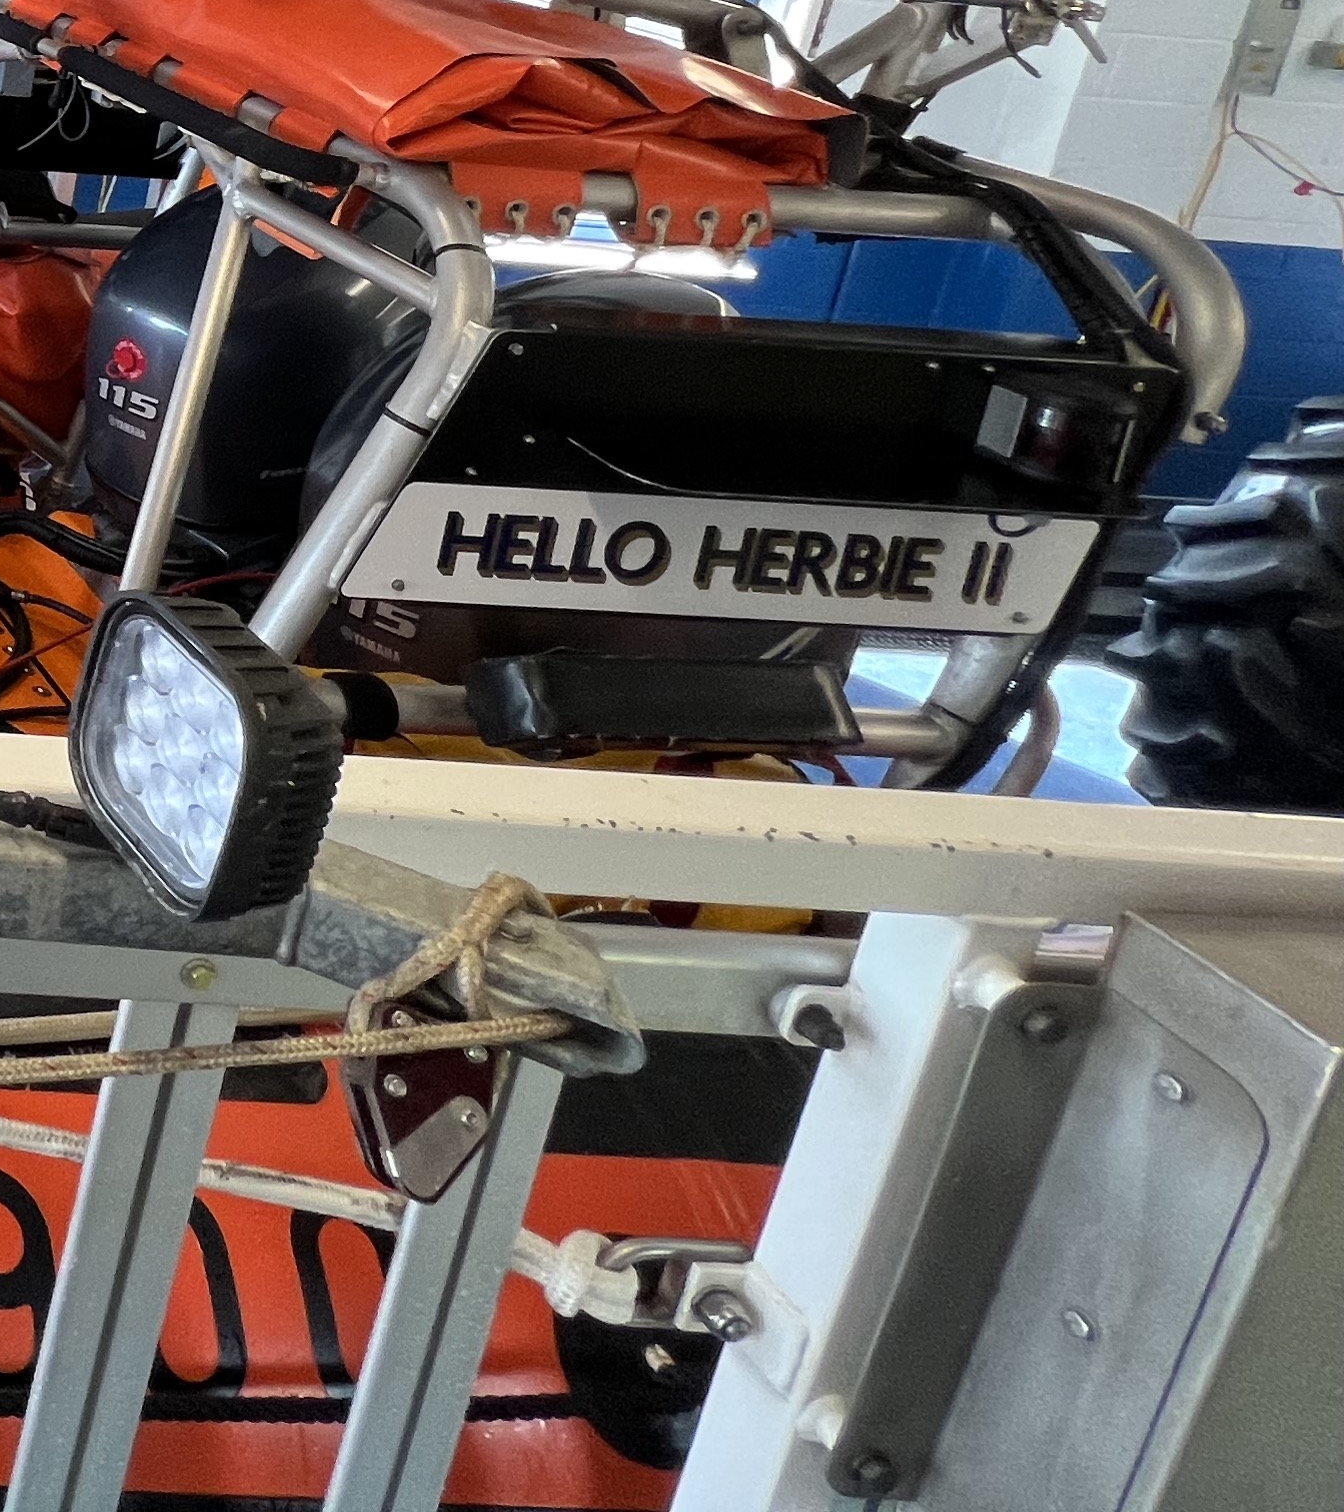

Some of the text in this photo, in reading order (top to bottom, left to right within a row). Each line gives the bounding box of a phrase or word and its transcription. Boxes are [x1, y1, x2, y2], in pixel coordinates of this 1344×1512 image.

[98, 377, 160, 420] 115
[436, 510, 1013, 607] HELLO HERBIE II
[348, 599, 420, 639] 15
